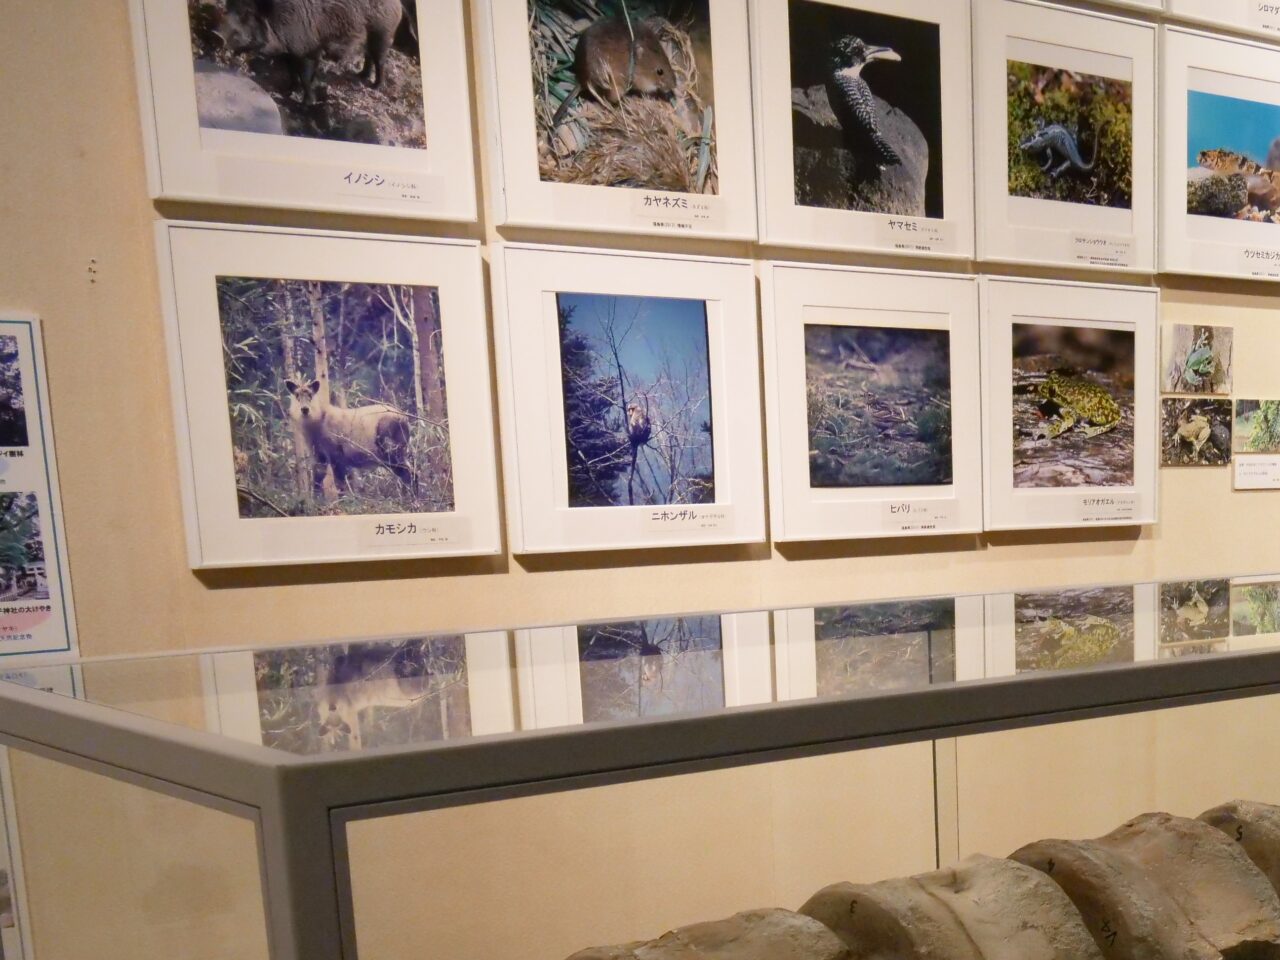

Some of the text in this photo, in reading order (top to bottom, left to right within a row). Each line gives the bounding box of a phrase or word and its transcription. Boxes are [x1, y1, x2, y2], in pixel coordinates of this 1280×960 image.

[344, 172, 385, 186] イノシシ
[643, 195, 689, 209] カヤネズミ
[888, 219, 918, 232] ヤマセミ
[890, 503, 911, 514] ヒバリ
[651, 510, 698, 522] ニホンザル
[375, 522, 417, 536] カモシカ
